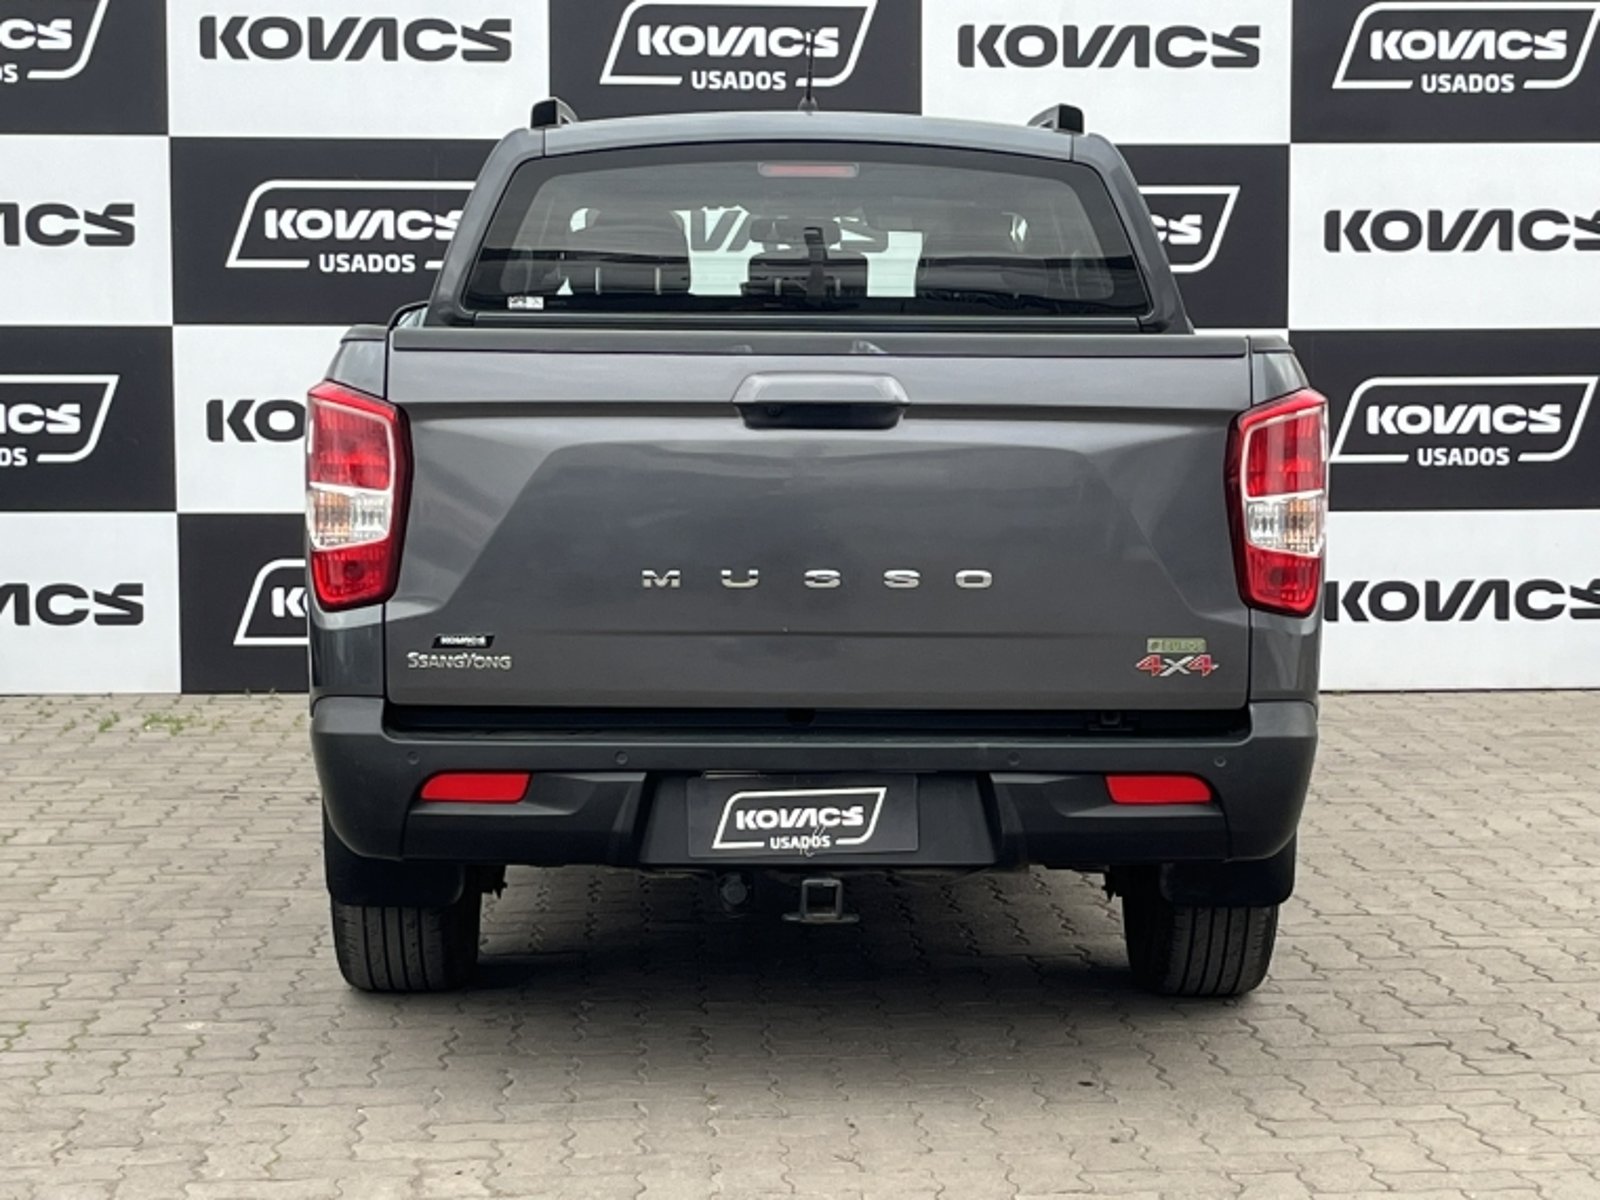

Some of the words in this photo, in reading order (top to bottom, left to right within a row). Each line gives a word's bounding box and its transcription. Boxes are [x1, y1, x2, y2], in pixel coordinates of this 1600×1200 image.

[199, 16, 511, 62] KOVACS
[637, 25, 839, 57] KOVACS
[957, 25, 1261, 68] KOVACS
[1370, 30, 1567, 60] KOVACS
[691, 70, 787, 91] USADOS
[1421, 74, 1515, 93] USADOS
[264, 208, 464, 241] KOVACS
[319, 253, 416, 273] USADOS
[1366, 404, 1561, 434] KOVACS
[1417, 447, 1510, 467] USADOS
[641, 569, 993, 588] MUSSO
[735, 806, 864, 830] KOVACS
[769, 835, 831, 849] USADOS
